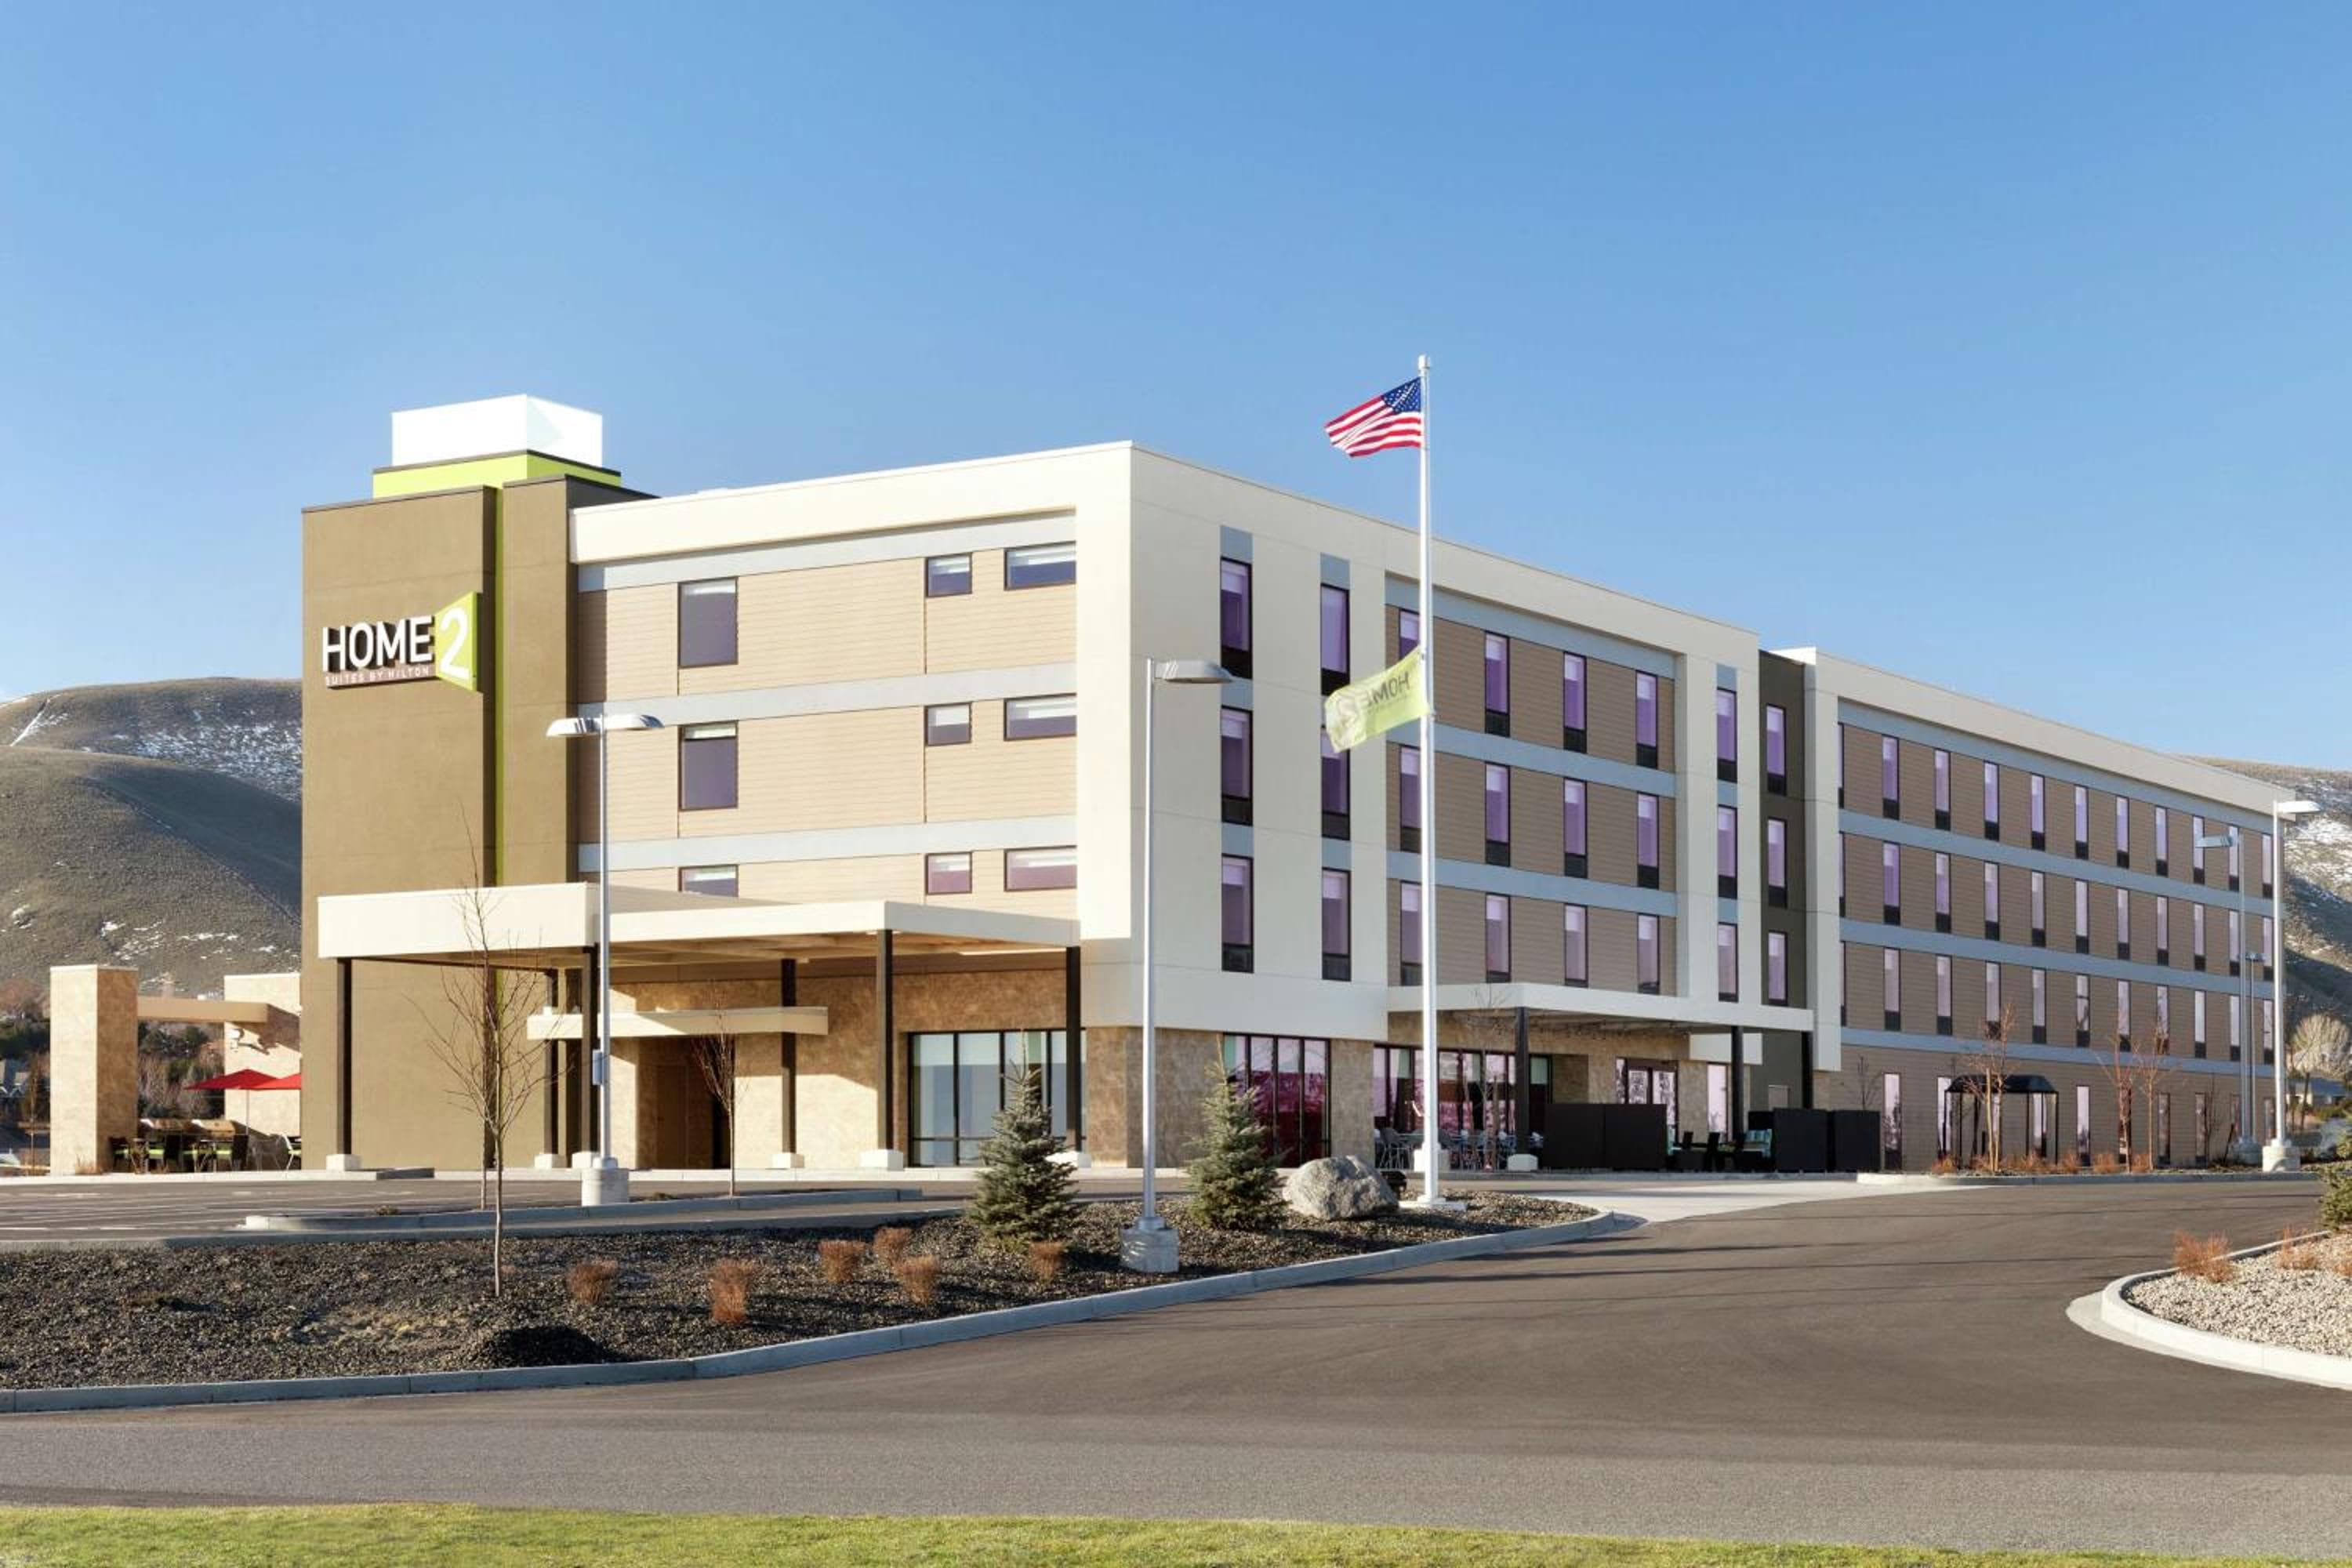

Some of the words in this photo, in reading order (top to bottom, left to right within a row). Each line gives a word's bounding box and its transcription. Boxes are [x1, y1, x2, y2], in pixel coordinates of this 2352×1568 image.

[322, 615, 433, 672] HOME
[440, 606, 471, 680] 2
[325, 673, 365, 687] SUITES
[369, 671, 383, 681] BY
[388, 666, 430, 679] HILTON
